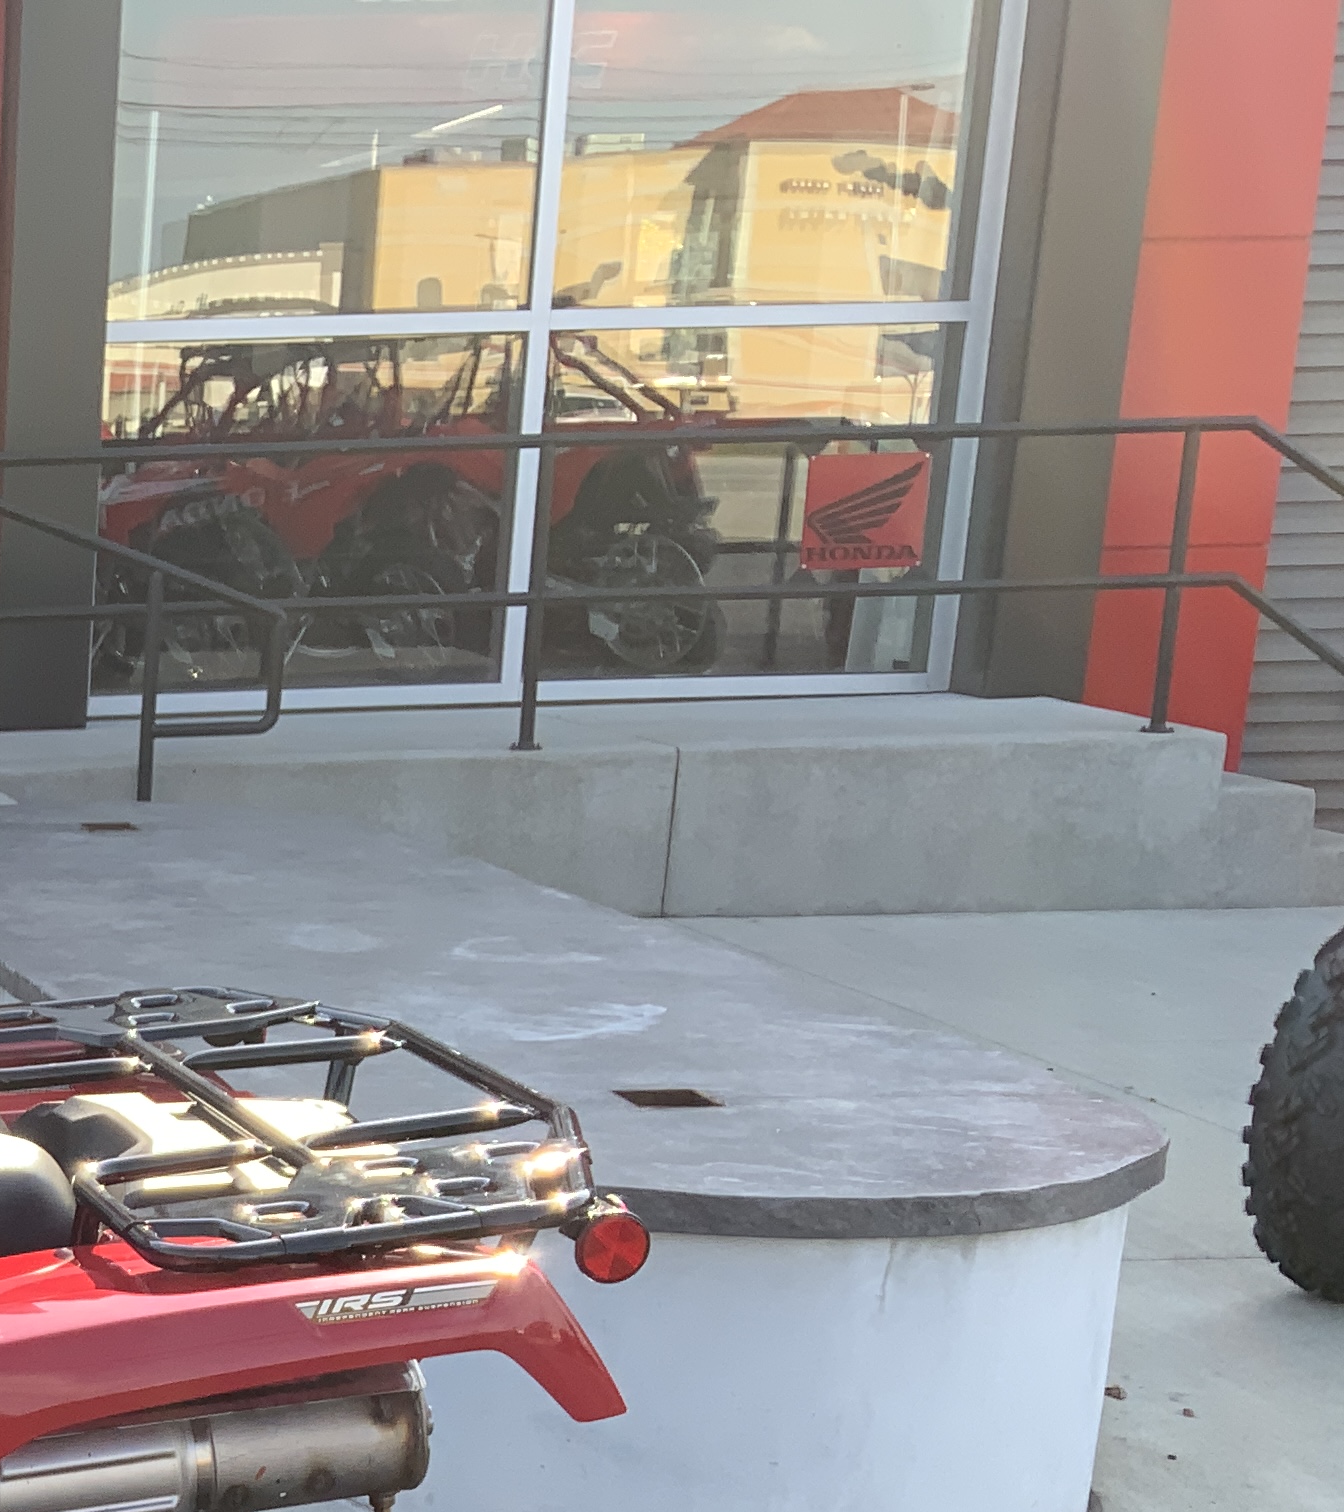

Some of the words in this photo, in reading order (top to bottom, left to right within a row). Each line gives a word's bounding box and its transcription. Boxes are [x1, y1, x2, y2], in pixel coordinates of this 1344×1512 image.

[805, 545, 919, 562] HONDA
[317, 1289, 408, 1315] IRS
[318, 1310, 387, 1323] INDEPENDENT
[389, 1306, 416, 1315] REAR
[417, 1299, 480, 1312] SUSPENSION
